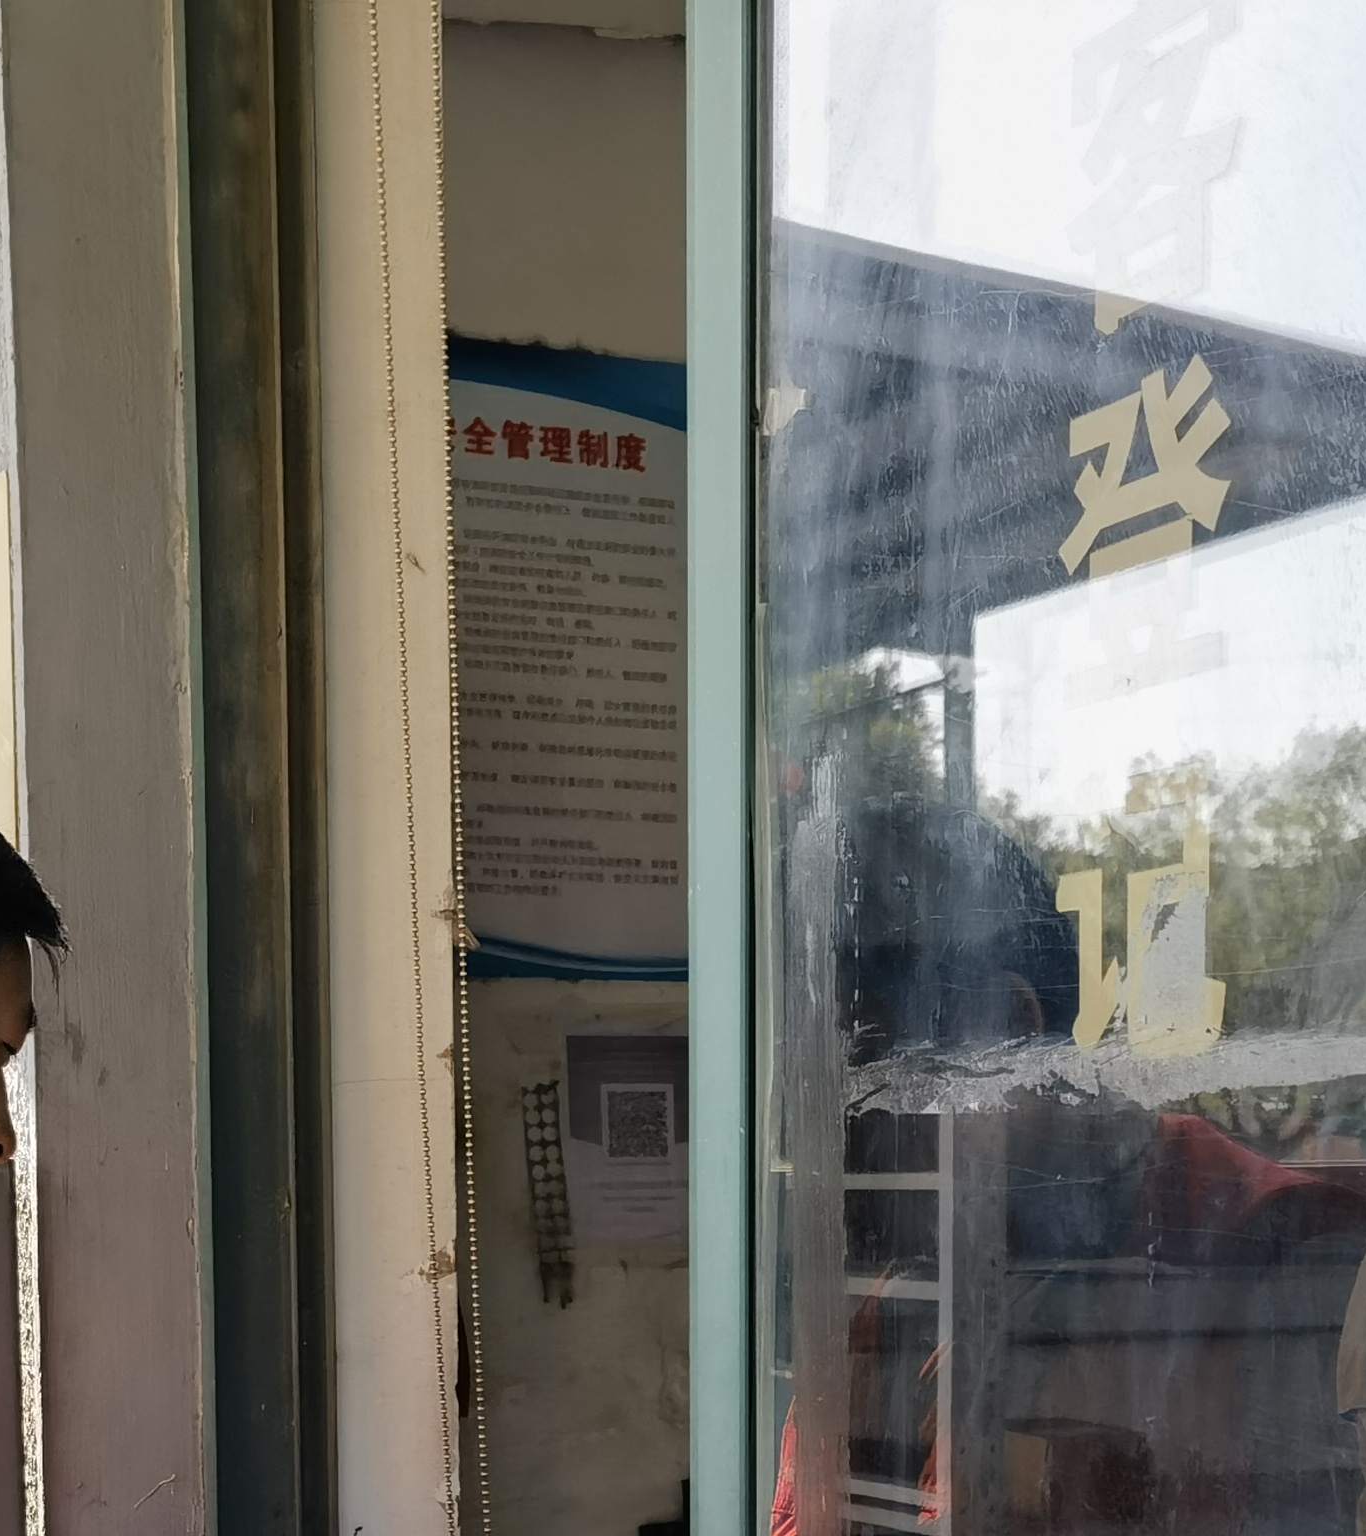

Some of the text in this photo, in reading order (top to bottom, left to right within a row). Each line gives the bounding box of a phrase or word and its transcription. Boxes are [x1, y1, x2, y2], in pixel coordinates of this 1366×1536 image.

[449, 417, 646, 472] 全管理制度
